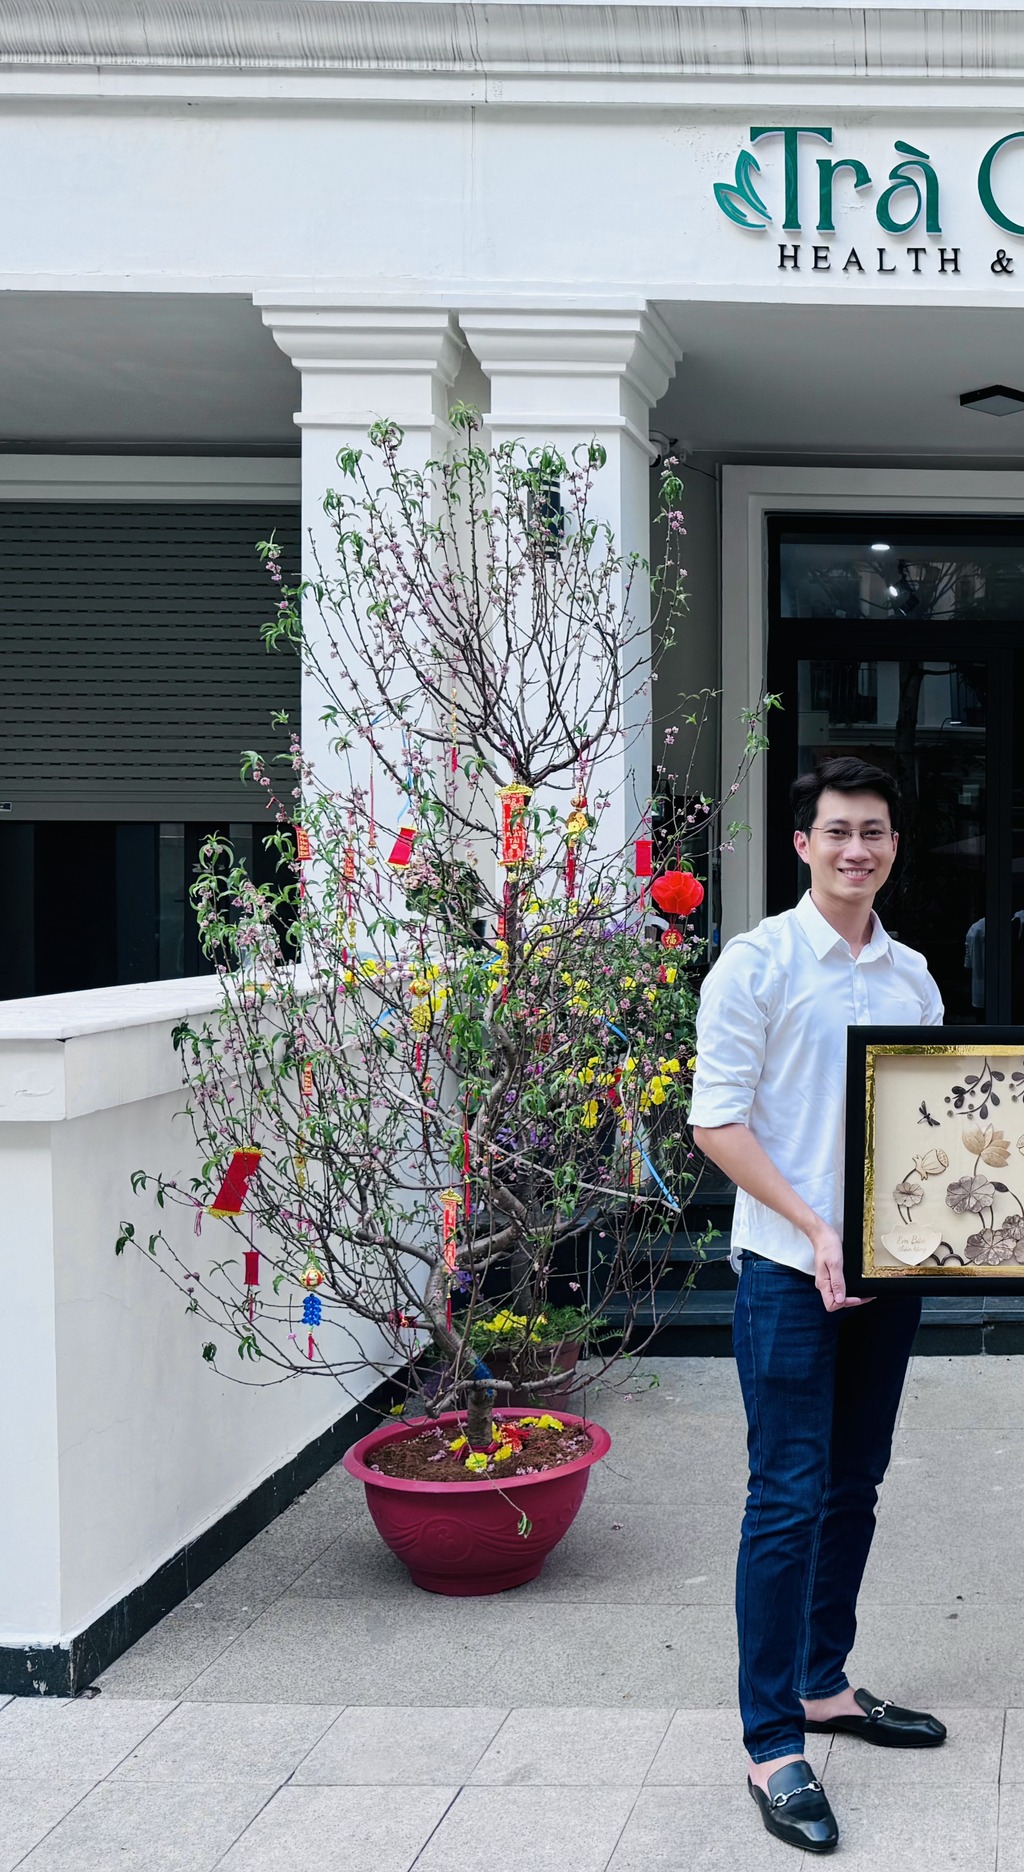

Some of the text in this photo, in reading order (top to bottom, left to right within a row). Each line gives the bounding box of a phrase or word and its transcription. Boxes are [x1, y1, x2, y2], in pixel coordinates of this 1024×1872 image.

[750, 127, 942, 236] Trà
[778, 244, 961, 273] HEALTH
[990, 249, 1015, 274] &
